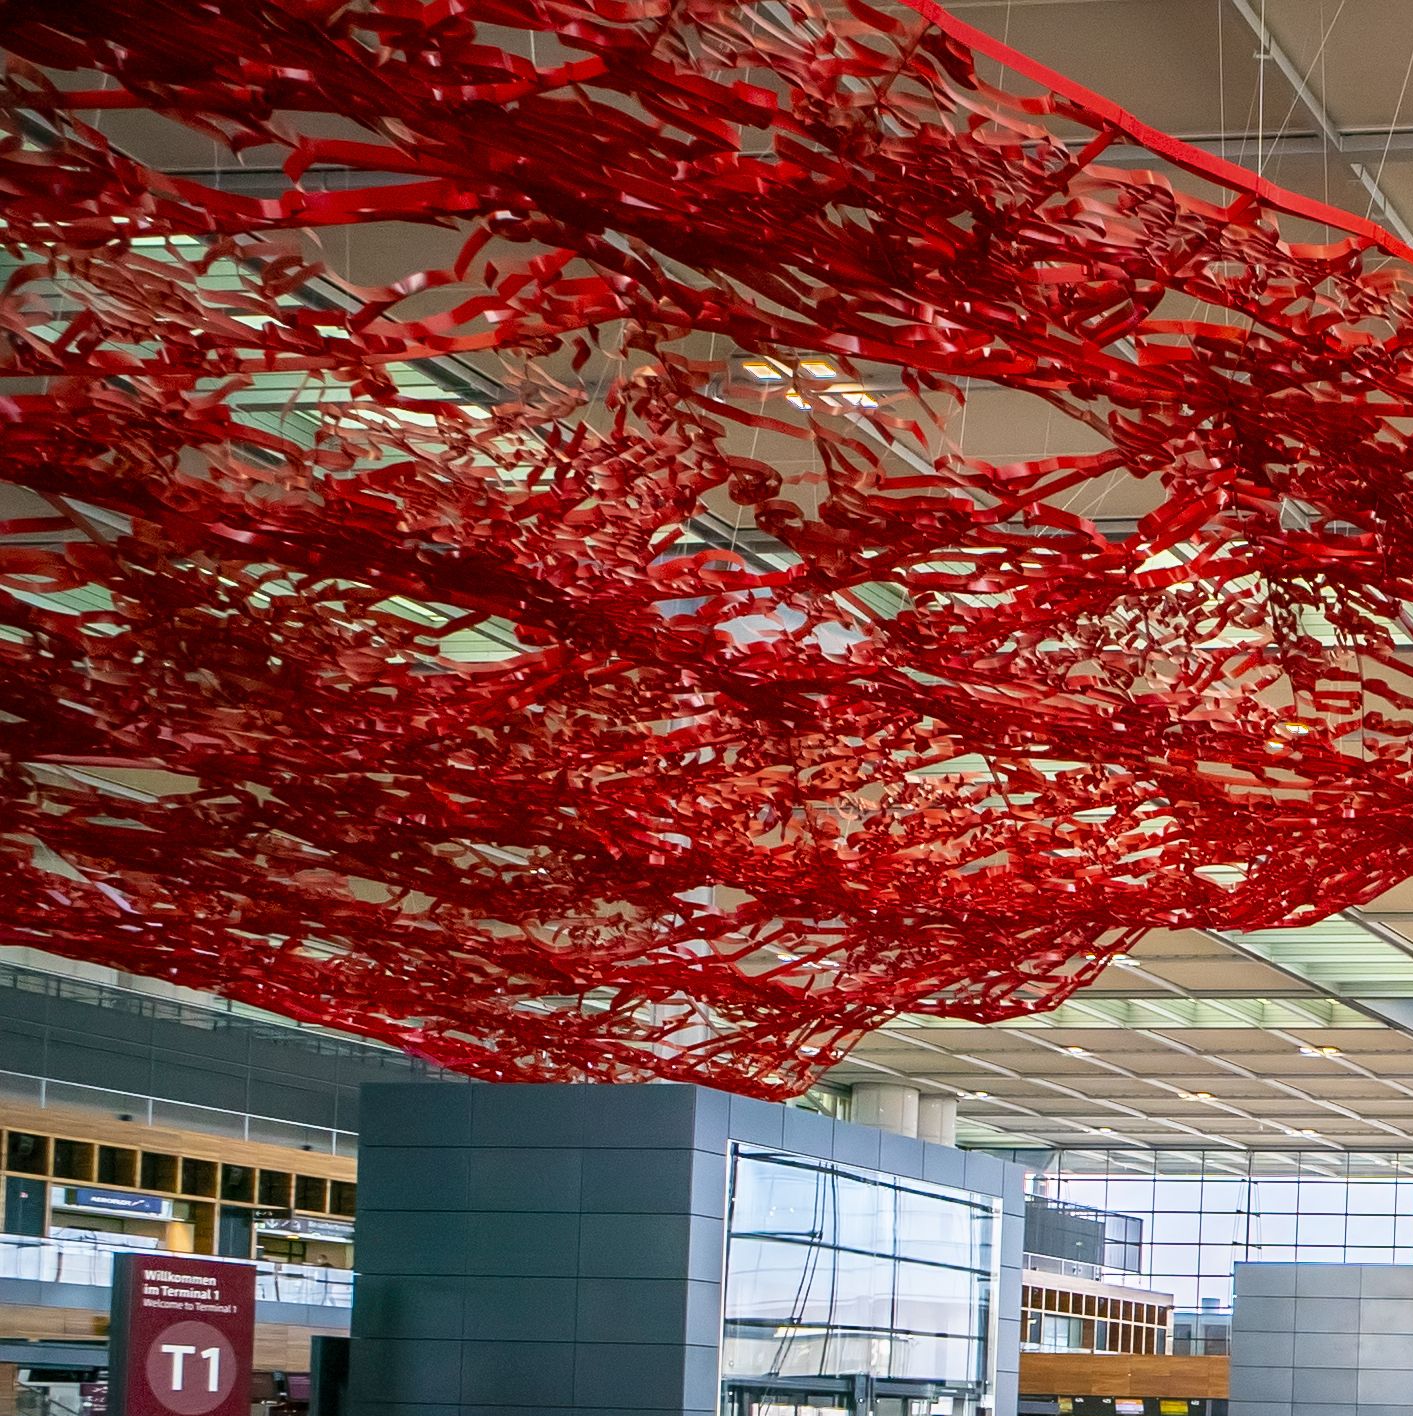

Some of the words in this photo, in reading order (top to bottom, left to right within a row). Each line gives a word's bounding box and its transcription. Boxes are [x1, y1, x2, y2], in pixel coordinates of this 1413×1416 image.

[144, 1269, 217, 1286] Willkommen
[143, 1283, 159, 1295] im
[160, 1286, 212, 1300] Terminal
[214, 1290, 220, 1300] 1
[143, 1298, 183, 1310] Welcome
[185, 1302, 194, 1310] to
[195, 1302, 232, 1313] Terminal
[232, 1305, 238, 1313] 1
[161, 1344, 220, 1392] T1
